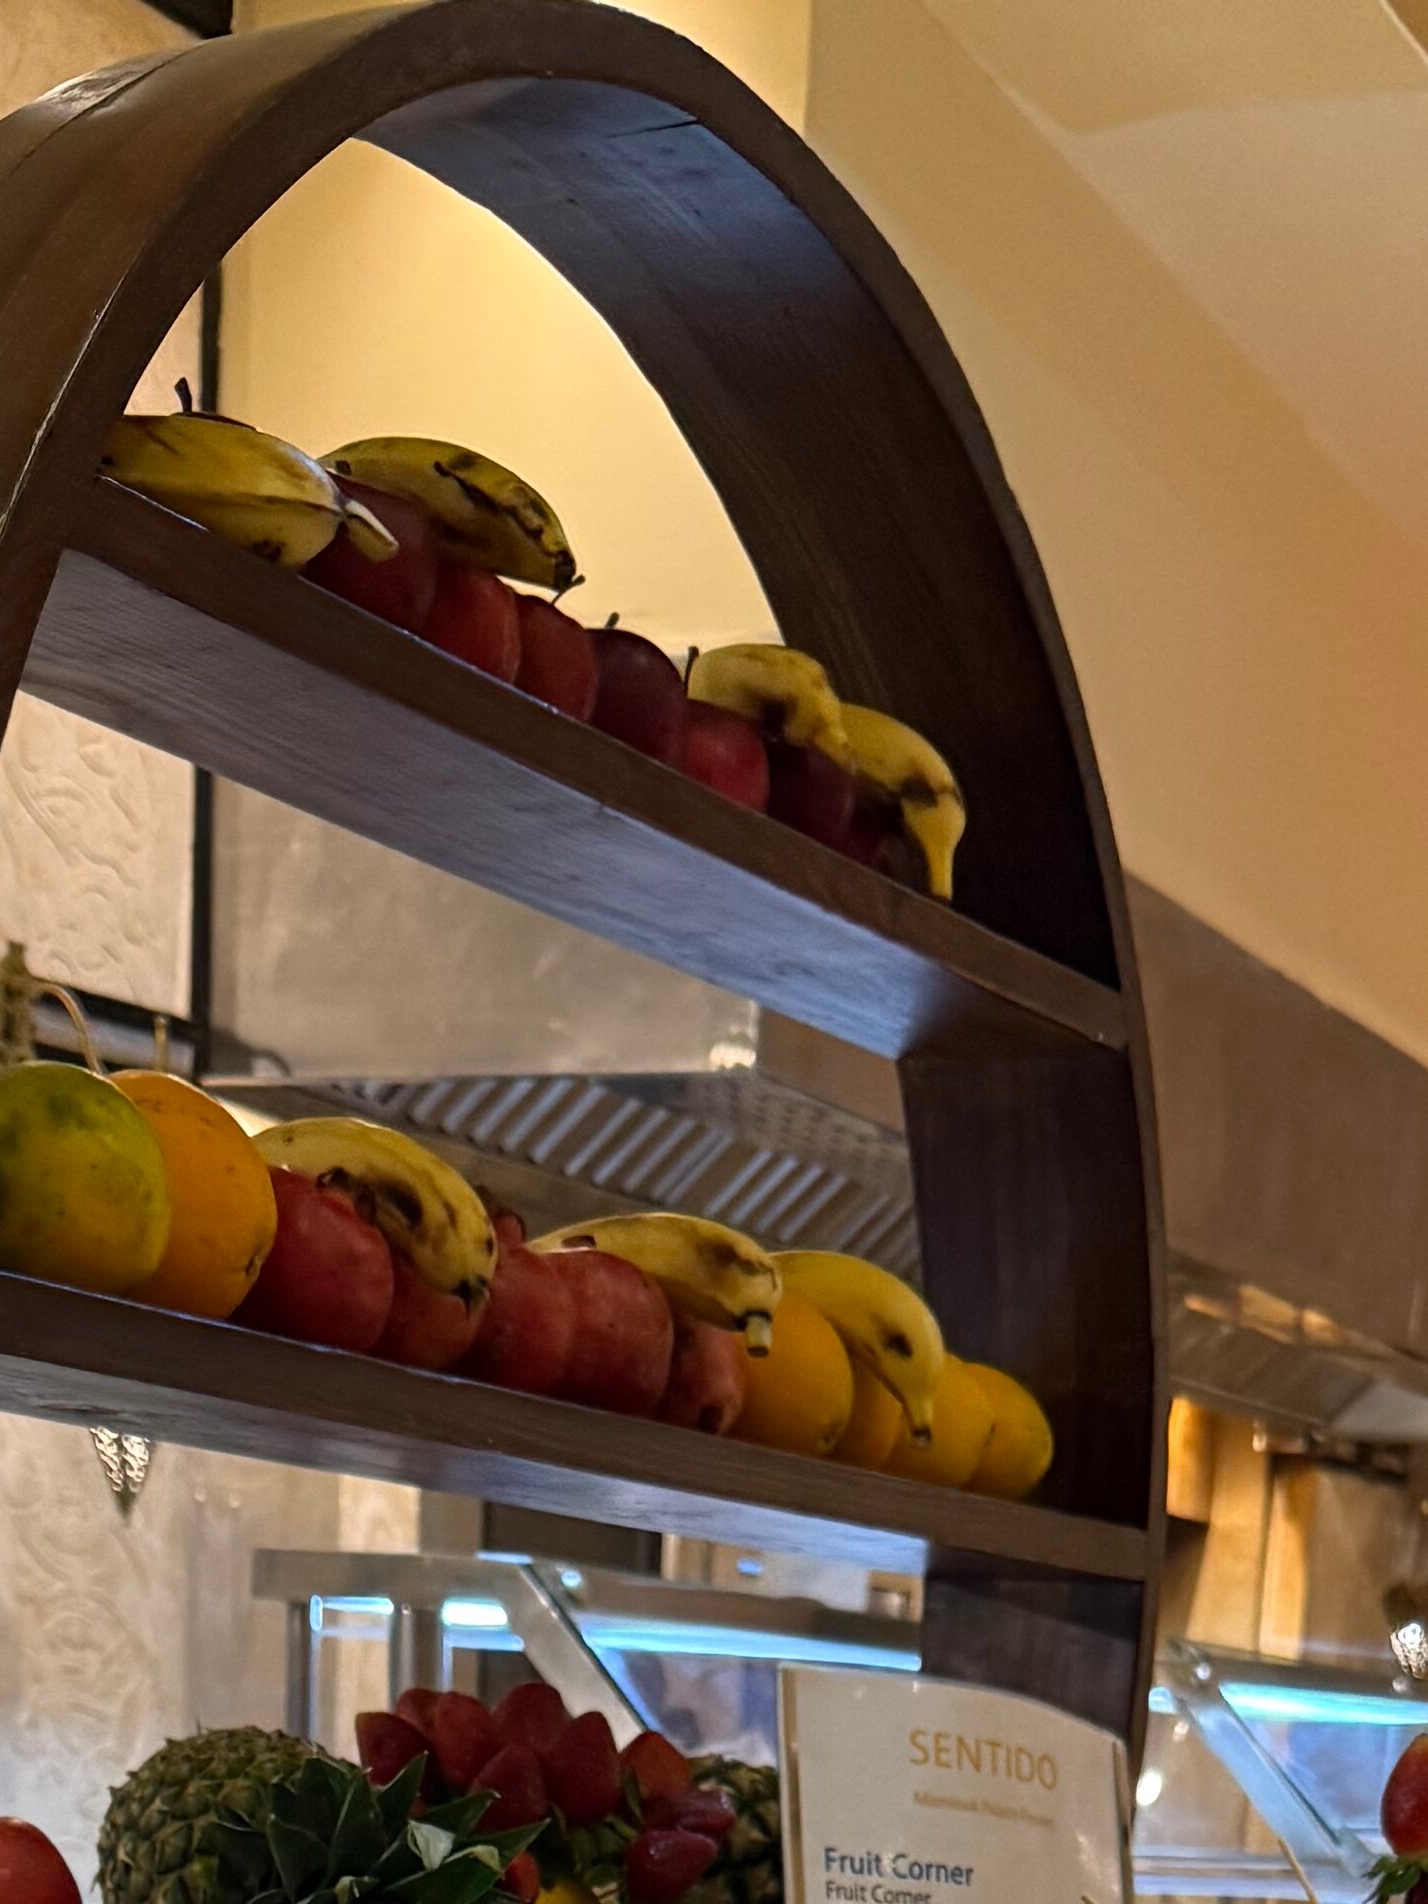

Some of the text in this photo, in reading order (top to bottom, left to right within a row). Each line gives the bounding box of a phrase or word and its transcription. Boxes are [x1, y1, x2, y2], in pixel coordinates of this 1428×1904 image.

[909, 1728, 1058, 1791] SENTIDO
[824, 1847, 974, 1887] Fruit Corner
[825, 1880, 868, 1903] Fruit
